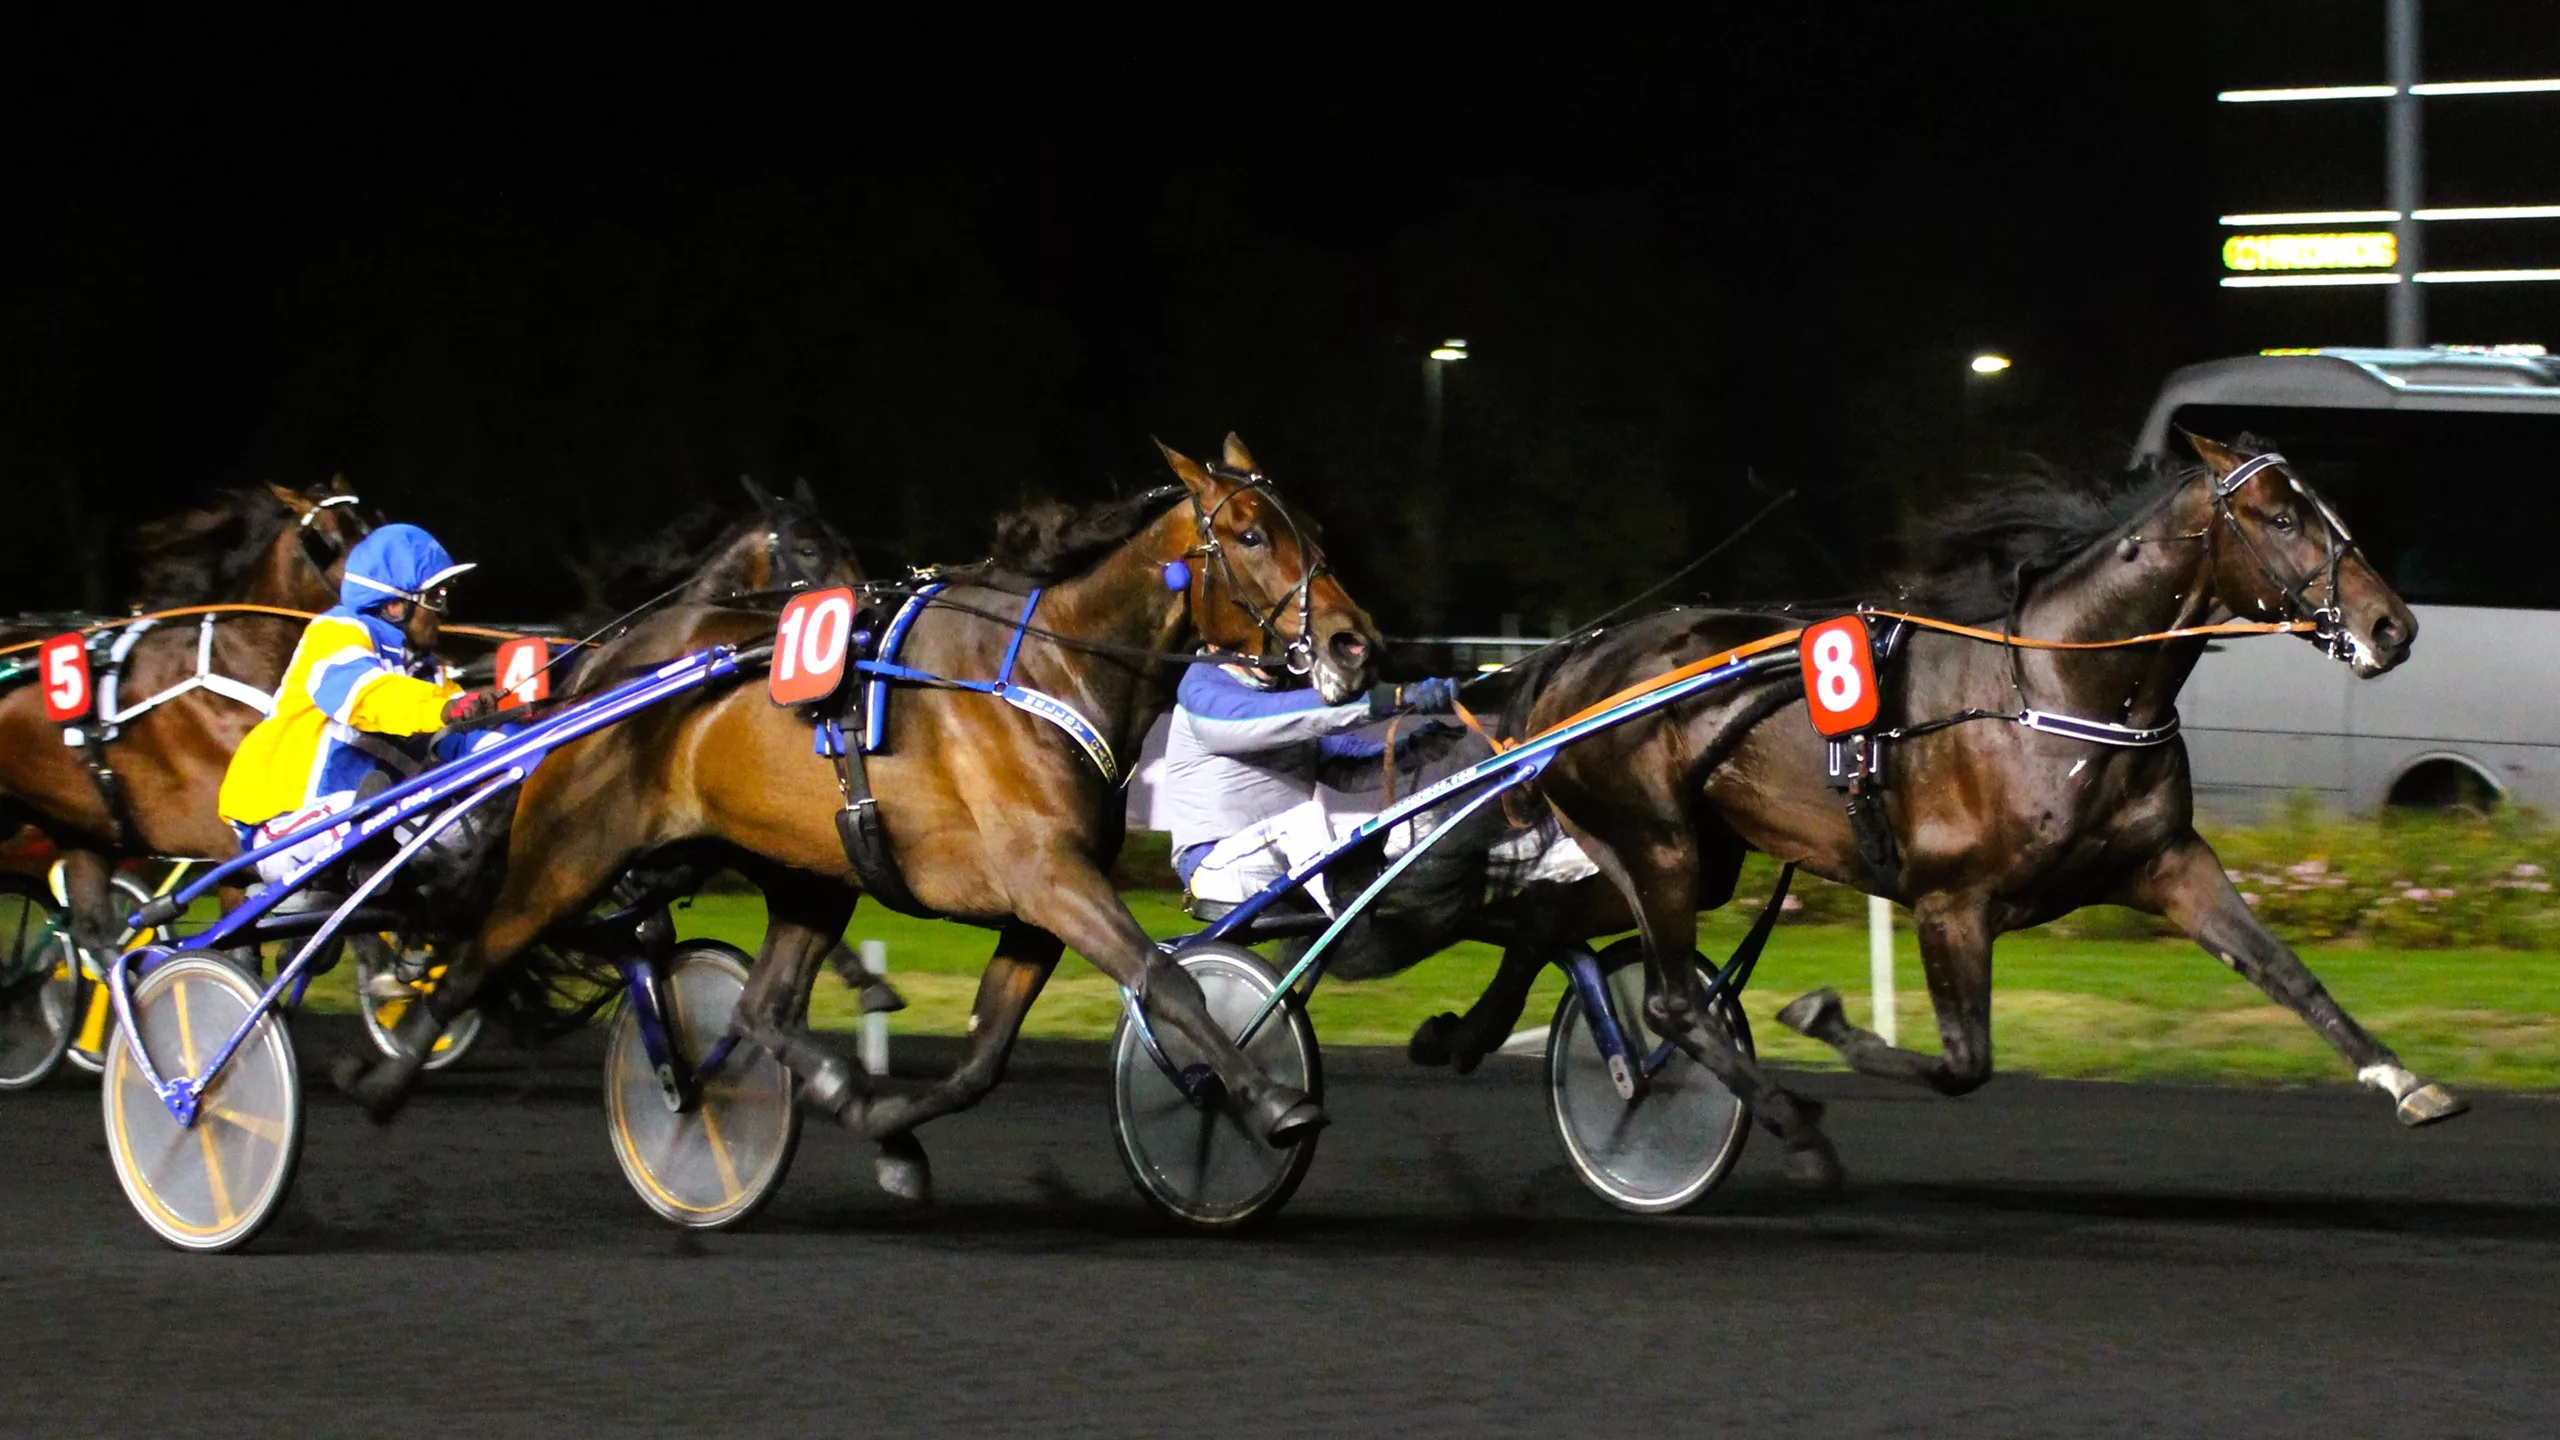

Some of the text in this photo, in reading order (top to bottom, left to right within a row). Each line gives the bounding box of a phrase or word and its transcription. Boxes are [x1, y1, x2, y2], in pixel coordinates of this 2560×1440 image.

[502, 645, 538, 703] 4
[781, 597, 850, 681] 10
[1813, 629, 1861, 713] 8
[50, 644, 83, 710] 5
